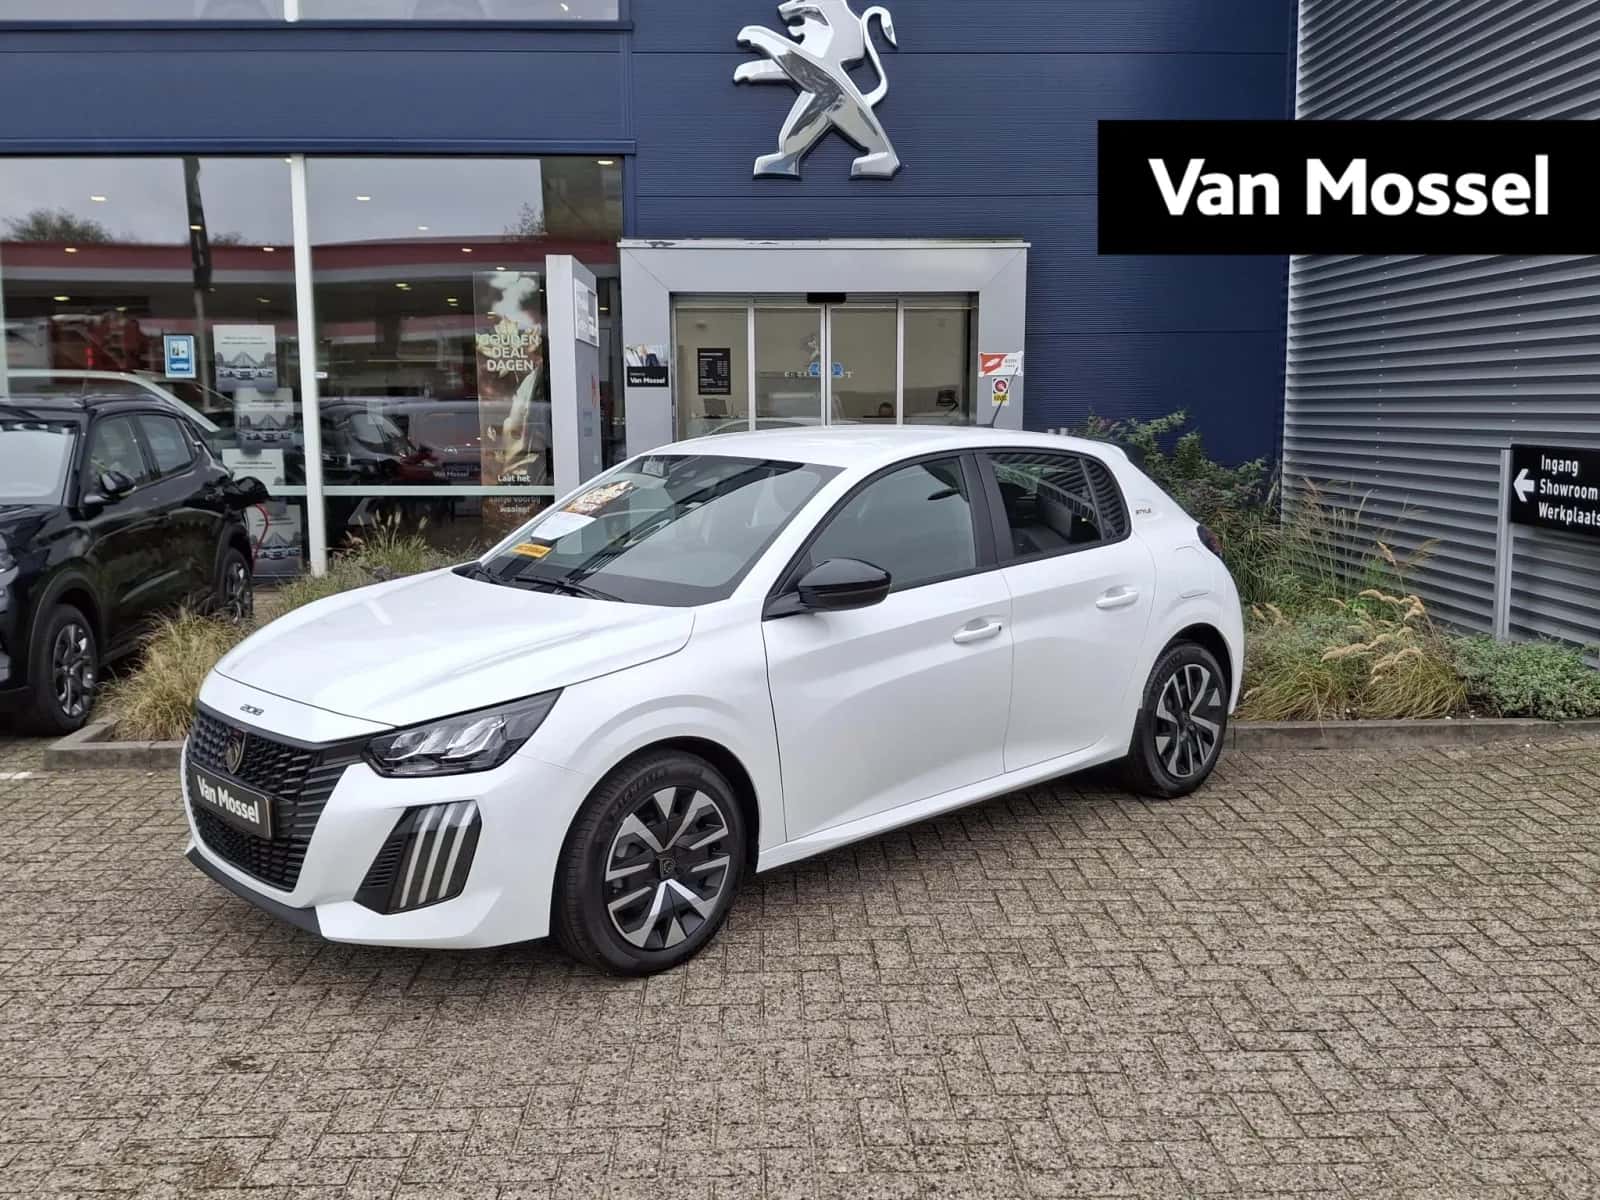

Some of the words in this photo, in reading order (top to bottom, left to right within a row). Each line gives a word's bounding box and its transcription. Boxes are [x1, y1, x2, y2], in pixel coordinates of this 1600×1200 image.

[492, 346, 528, 359] DEAL
[487, 359, 534, 372] DAGEN
[1541, 454, 1579, 477] Ingang
[1539, 478, 1598, 500] Showroom
[240, 703, 265, 716] 208
[196, 775, 217, 805] Van
[217, 786, 260, 825] Mossel
